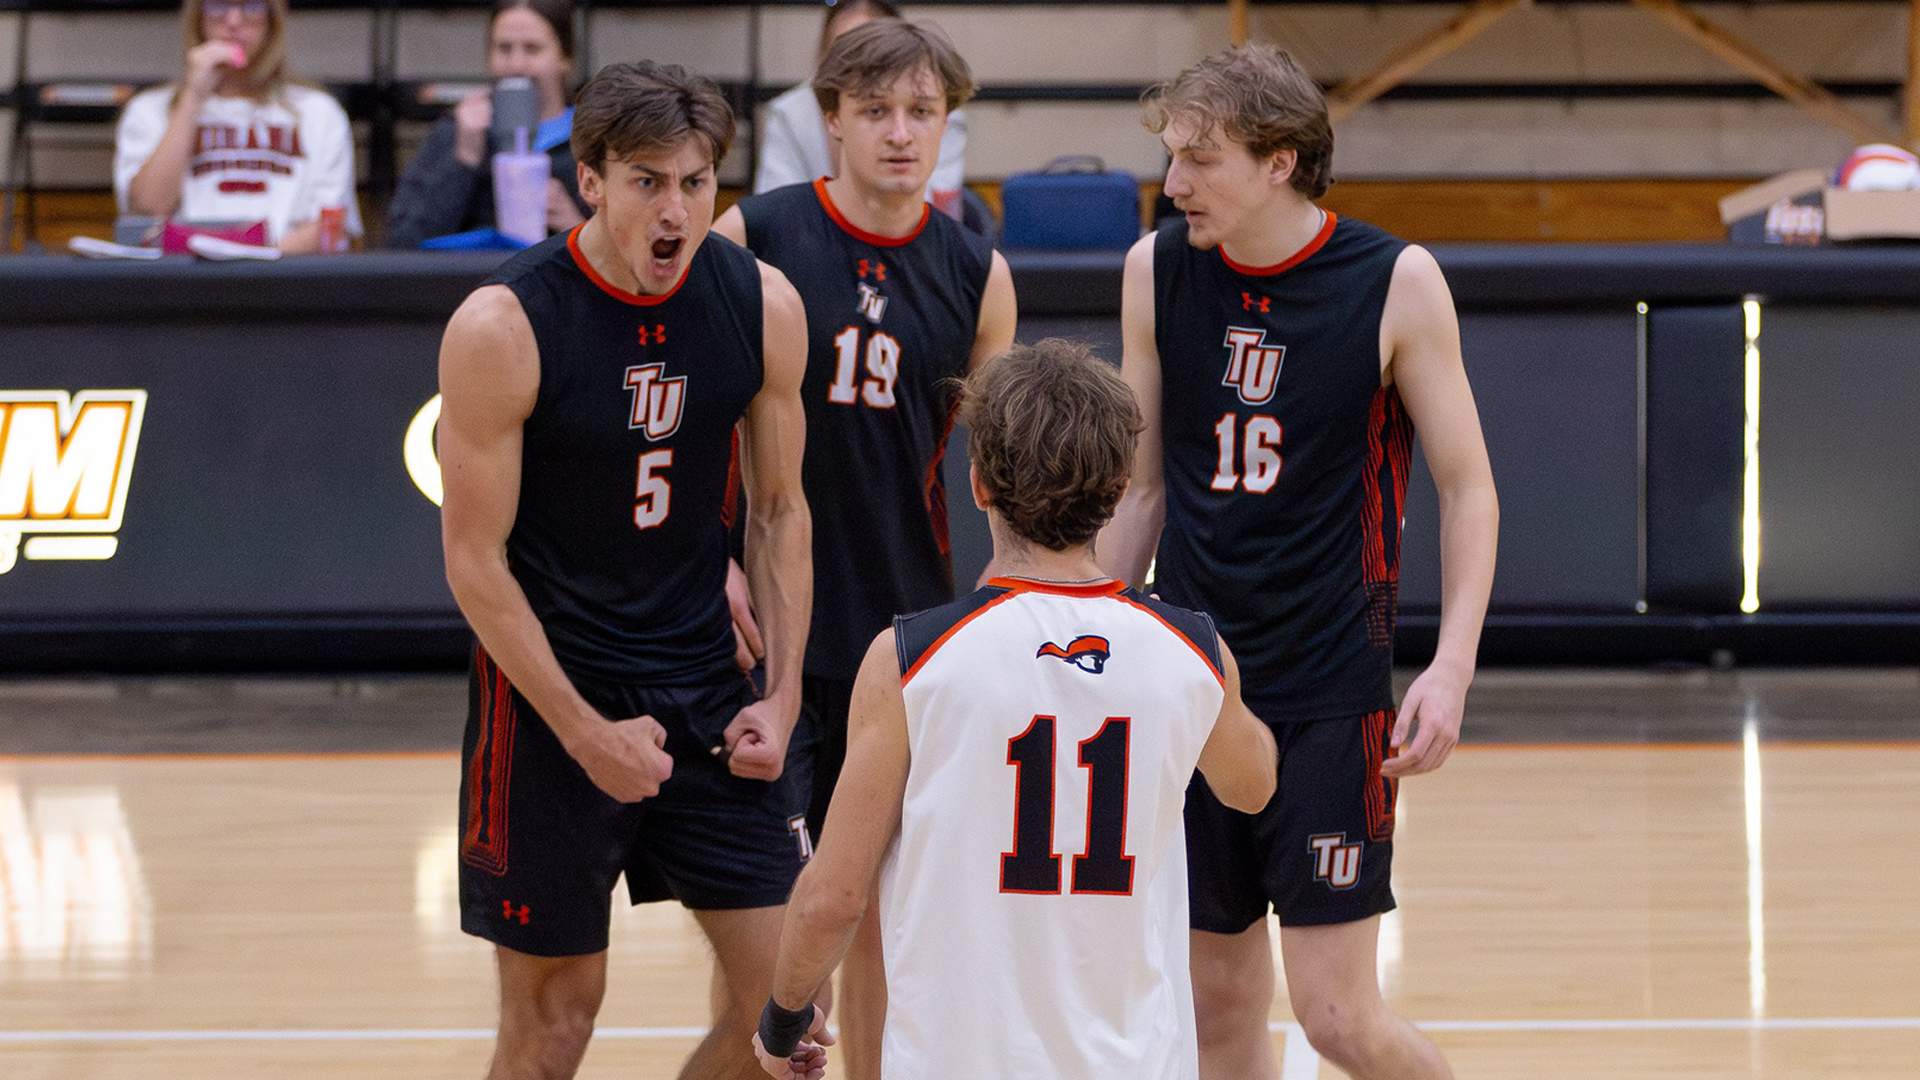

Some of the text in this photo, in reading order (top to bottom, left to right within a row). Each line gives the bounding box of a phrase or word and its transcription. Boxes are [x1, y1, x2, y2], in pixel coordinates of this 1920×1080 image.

[856, 281, 889, 324] TU
[623, 362, 688, 442] TU
[827, 325, 902, 410] 19
[1222, 325, 1287, 406] TU
[633, 449, 674, 530] 5
[1210, 412, 1284, 495] 16
[999, 714, 1136, 897] 11
[1307, 831, 1364, 891] TU
